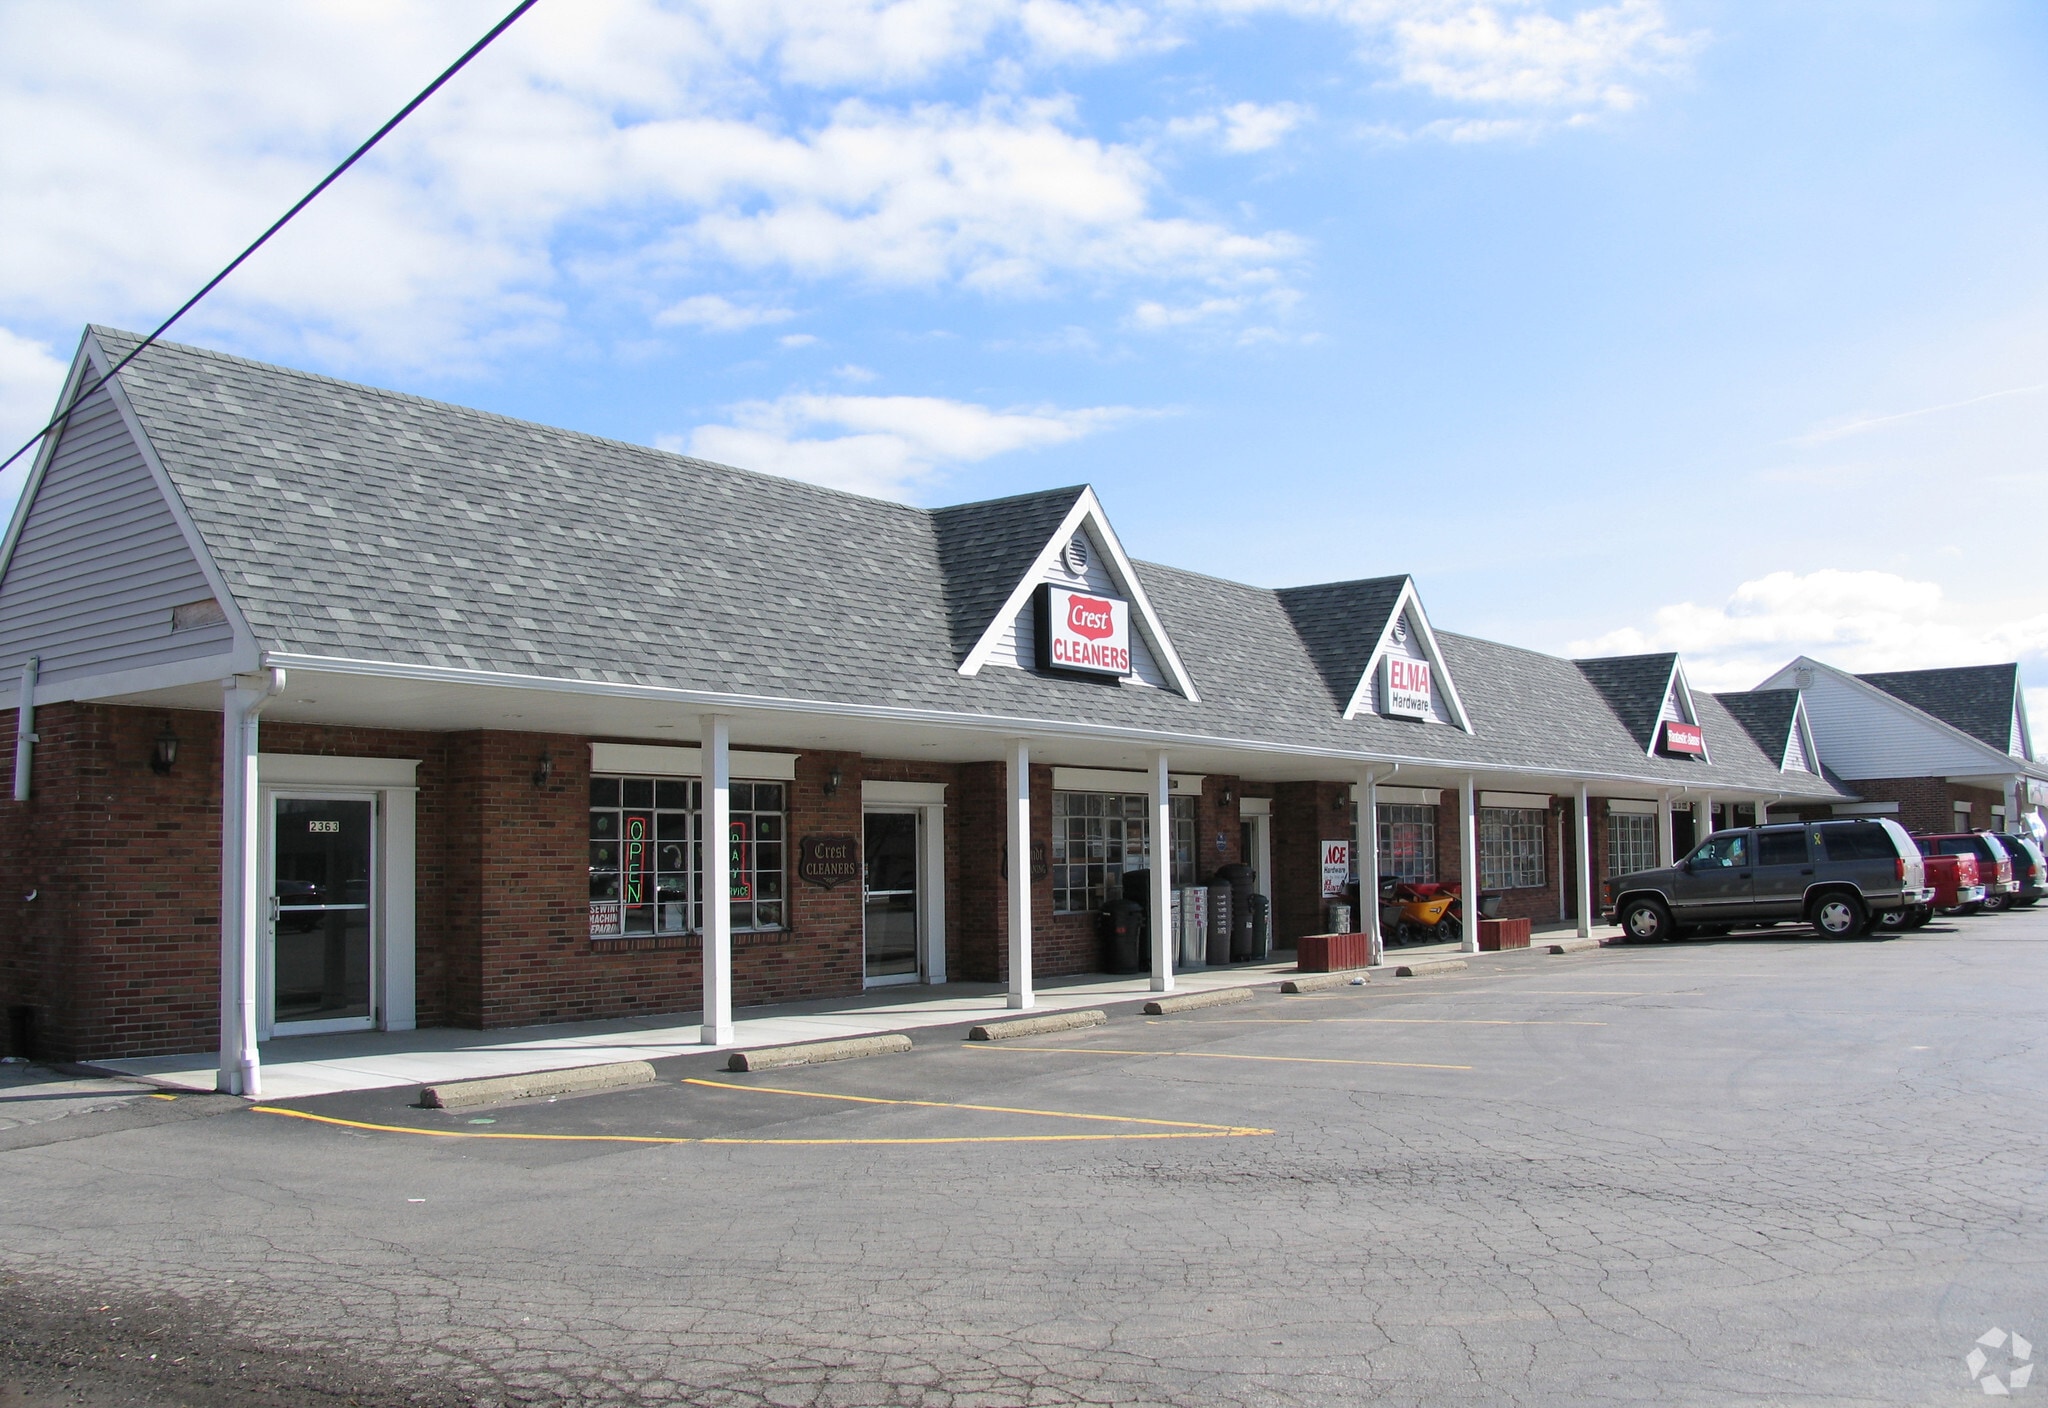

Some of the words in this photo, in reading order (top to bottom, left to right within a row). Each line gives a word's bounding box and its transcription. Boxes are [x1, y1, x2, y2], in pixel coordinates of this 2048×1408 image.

[1072, 605, 1108, 630] Crest
[1054, 638, 1128, 670] CLEANERS
[1391, 660, 1429, 694] ELMA
[1392, 692, 1429, 711] Hardware
[310, 821, 338, 831] 2363
[814, 842, 847, 859] Crest
[1325, 845, 1346, 864] ACE
[628, 821, 643, 903] OPEN
[806, 862, 855, 875] CLEANERS
[730, 886, 748, 896] RVICE
[589, 913, 618, 924] MACHIN
[590, 924, 619, 935] EPAIRIN
